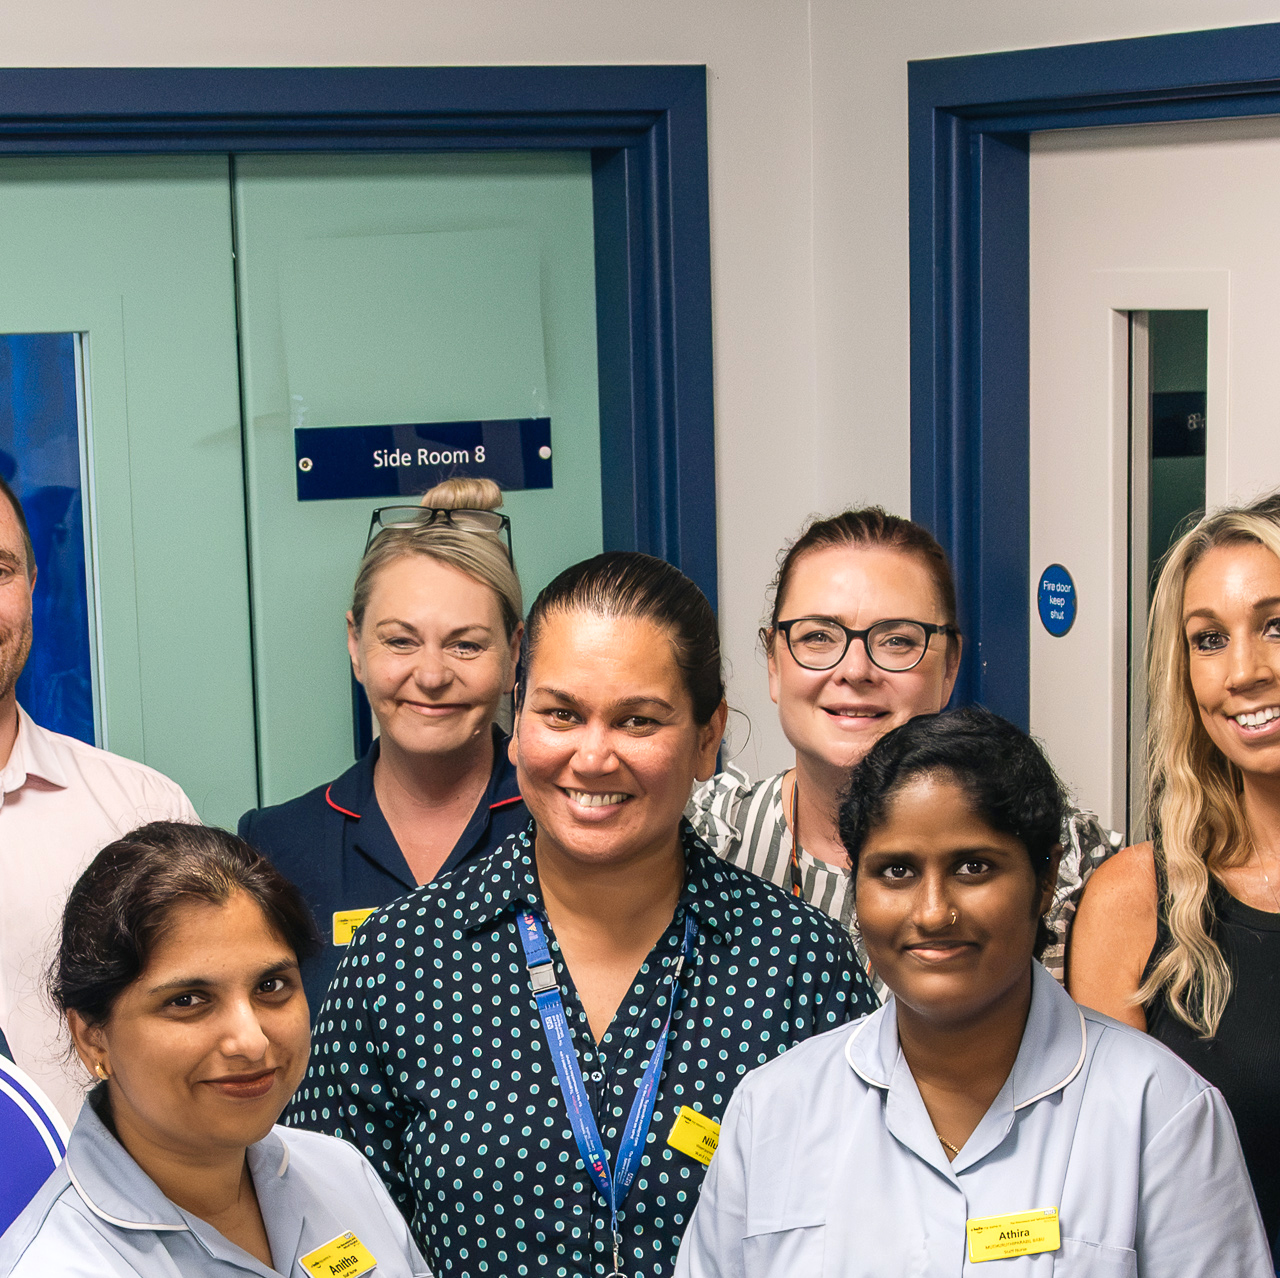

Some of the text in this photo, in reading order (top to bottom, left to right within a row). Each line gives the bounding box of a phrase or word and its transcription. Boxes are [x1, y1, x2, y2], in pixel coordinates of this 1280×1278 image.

[374, 446, 485, 468] Side Room 8
[1043, 580, 1071, 592] Fire door
[1050, 595, 1065, 608] keep
[1051, 609, 1064, 620] shut
[999, 1229, 1030, 1241] Athira
[329, 1255, 358, 1275] Anitha
